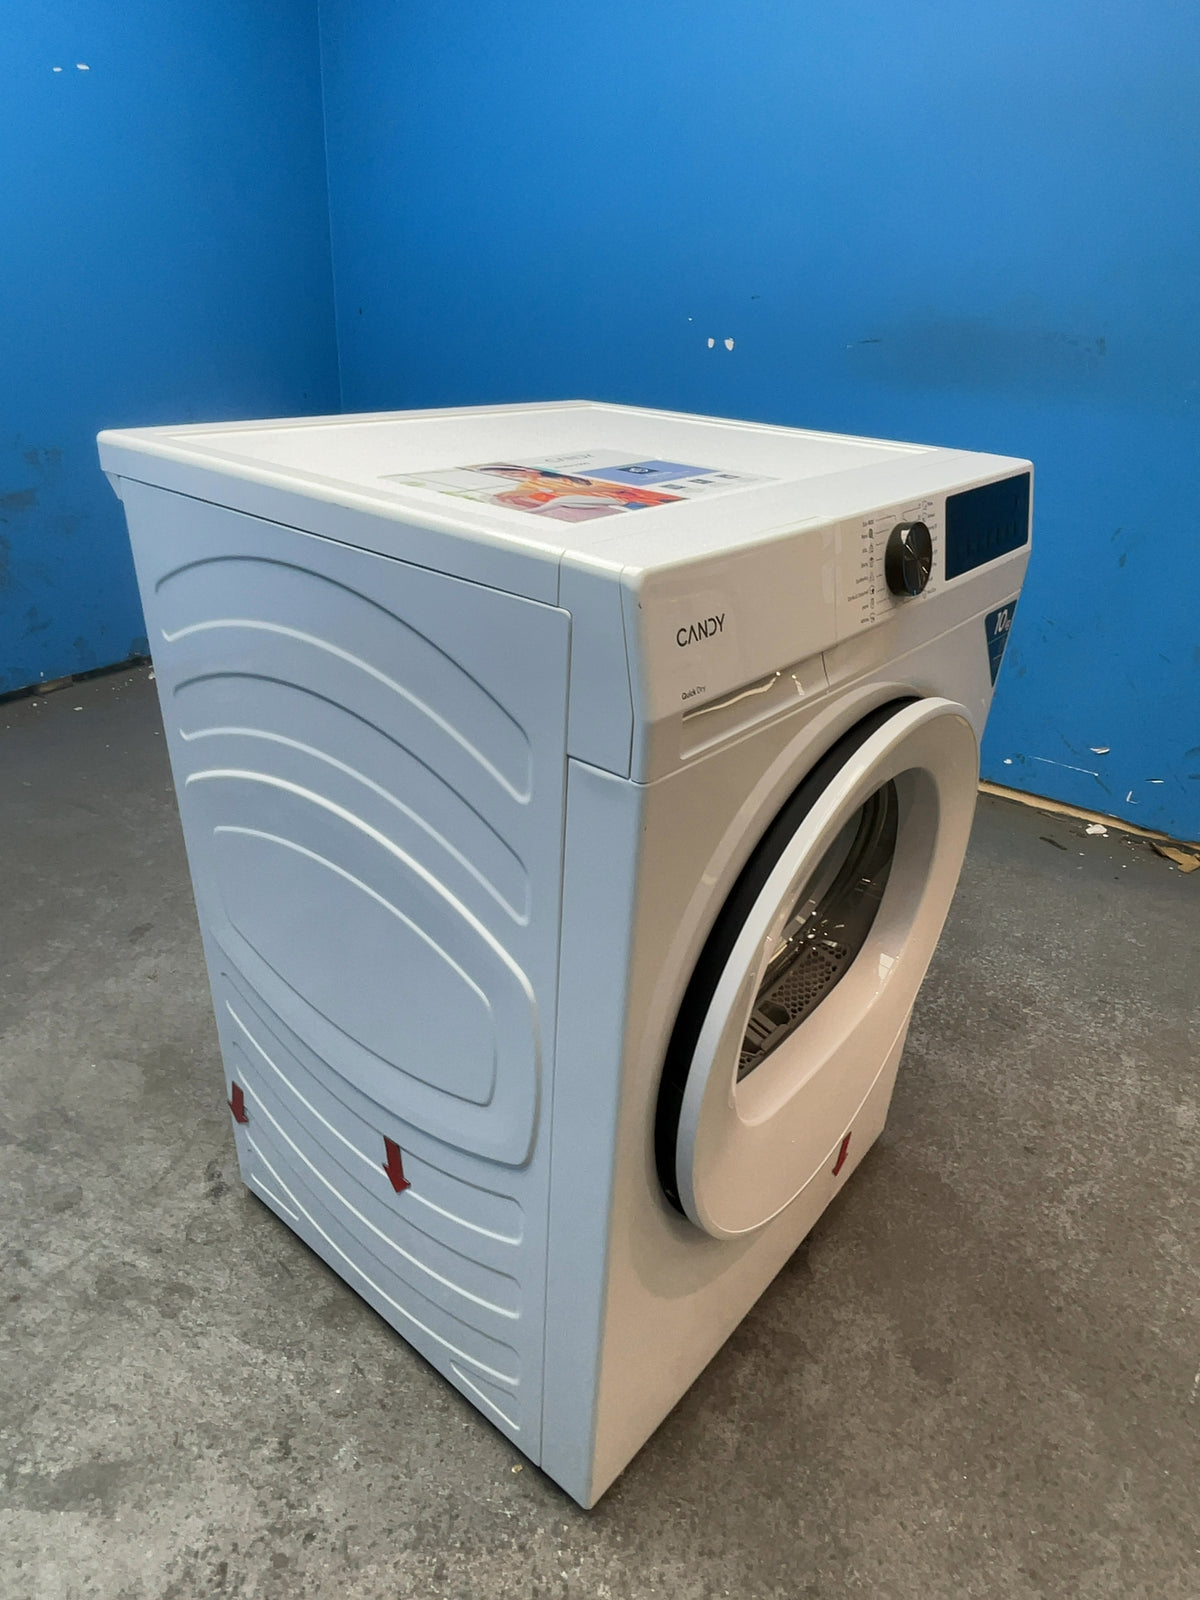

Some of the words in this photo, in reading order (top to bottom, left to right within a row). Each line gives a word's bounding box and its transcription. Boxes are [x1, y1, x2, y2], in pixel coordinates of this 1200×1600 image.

[676, 613, 725, 647] CANDY
[994, 609, 1008, 635] 10
[681, 687, 697, 701] Quick
[696, 685, 706, 694] Dry
